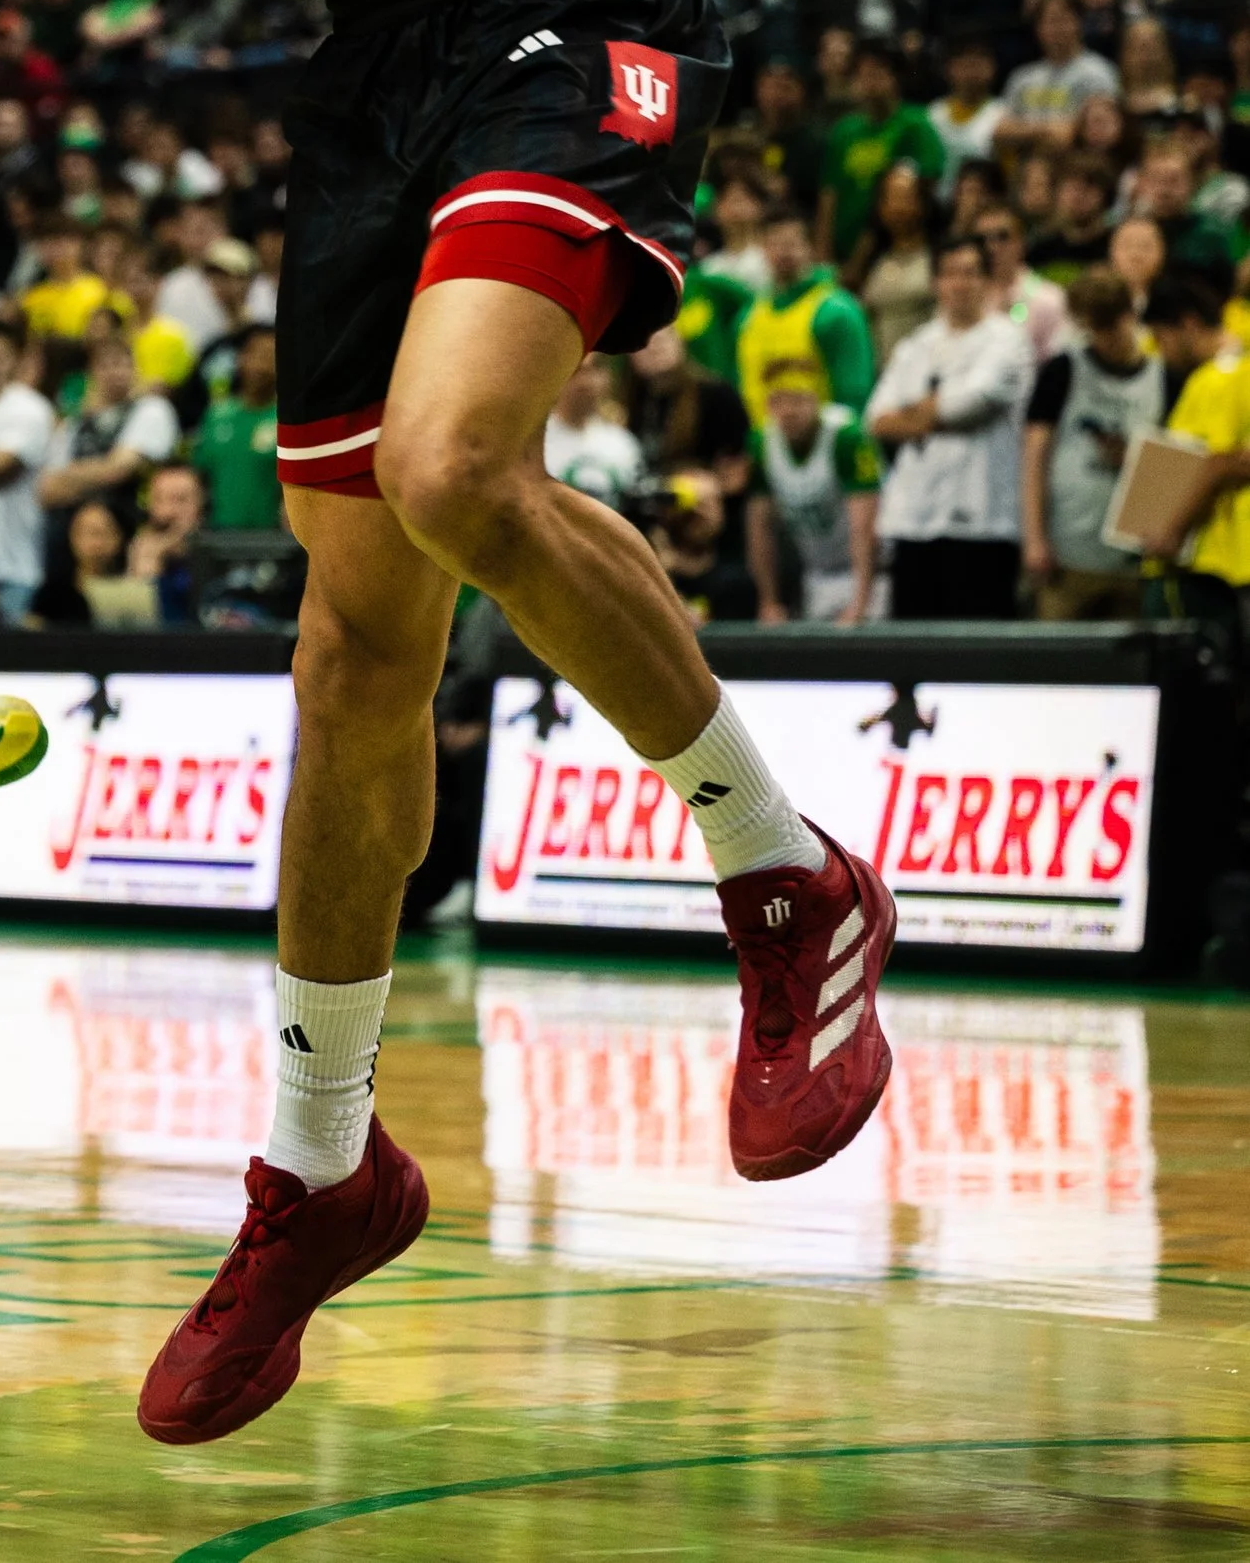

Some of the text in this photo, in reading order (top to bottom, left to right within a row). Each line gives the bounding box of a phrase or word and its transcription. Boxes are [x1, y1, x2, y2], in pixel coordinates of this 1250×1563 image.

[619, 63, 670, 123] IU
[51, 734, 271, 871] JERRY'S
[868, 742, 1140, 881] JERRY'S
